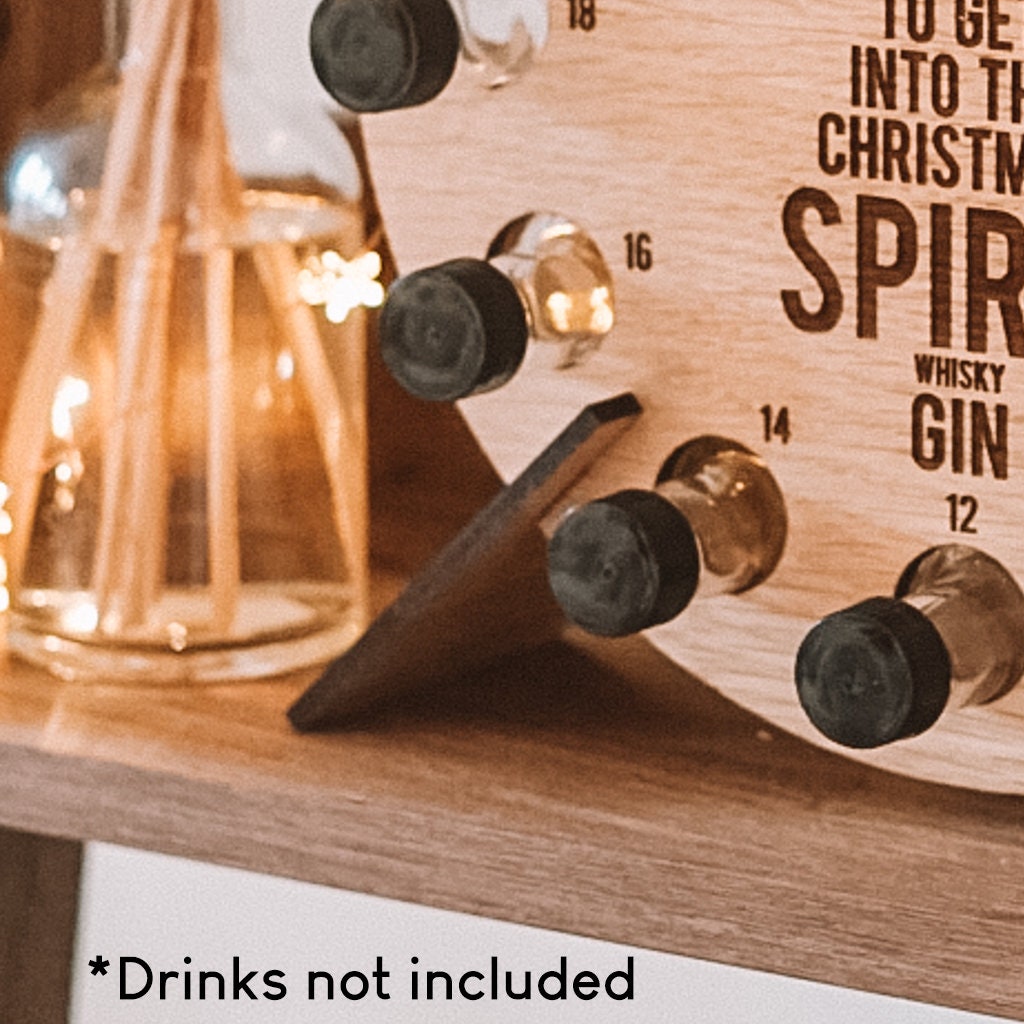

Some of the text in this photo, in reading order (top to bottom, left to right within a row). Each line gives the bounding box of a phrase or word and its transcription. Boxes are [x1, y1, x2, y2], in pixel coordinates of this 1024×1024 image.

[849, 45, 960, 118] INTO
[624, 232, 653, 271] 16
[914, 352, 1006, 394] WHISKY
[760, 404, 791, 444] 14
[910, 393, 1009, 480] GIN
[945, 493, 978, 534] 12
